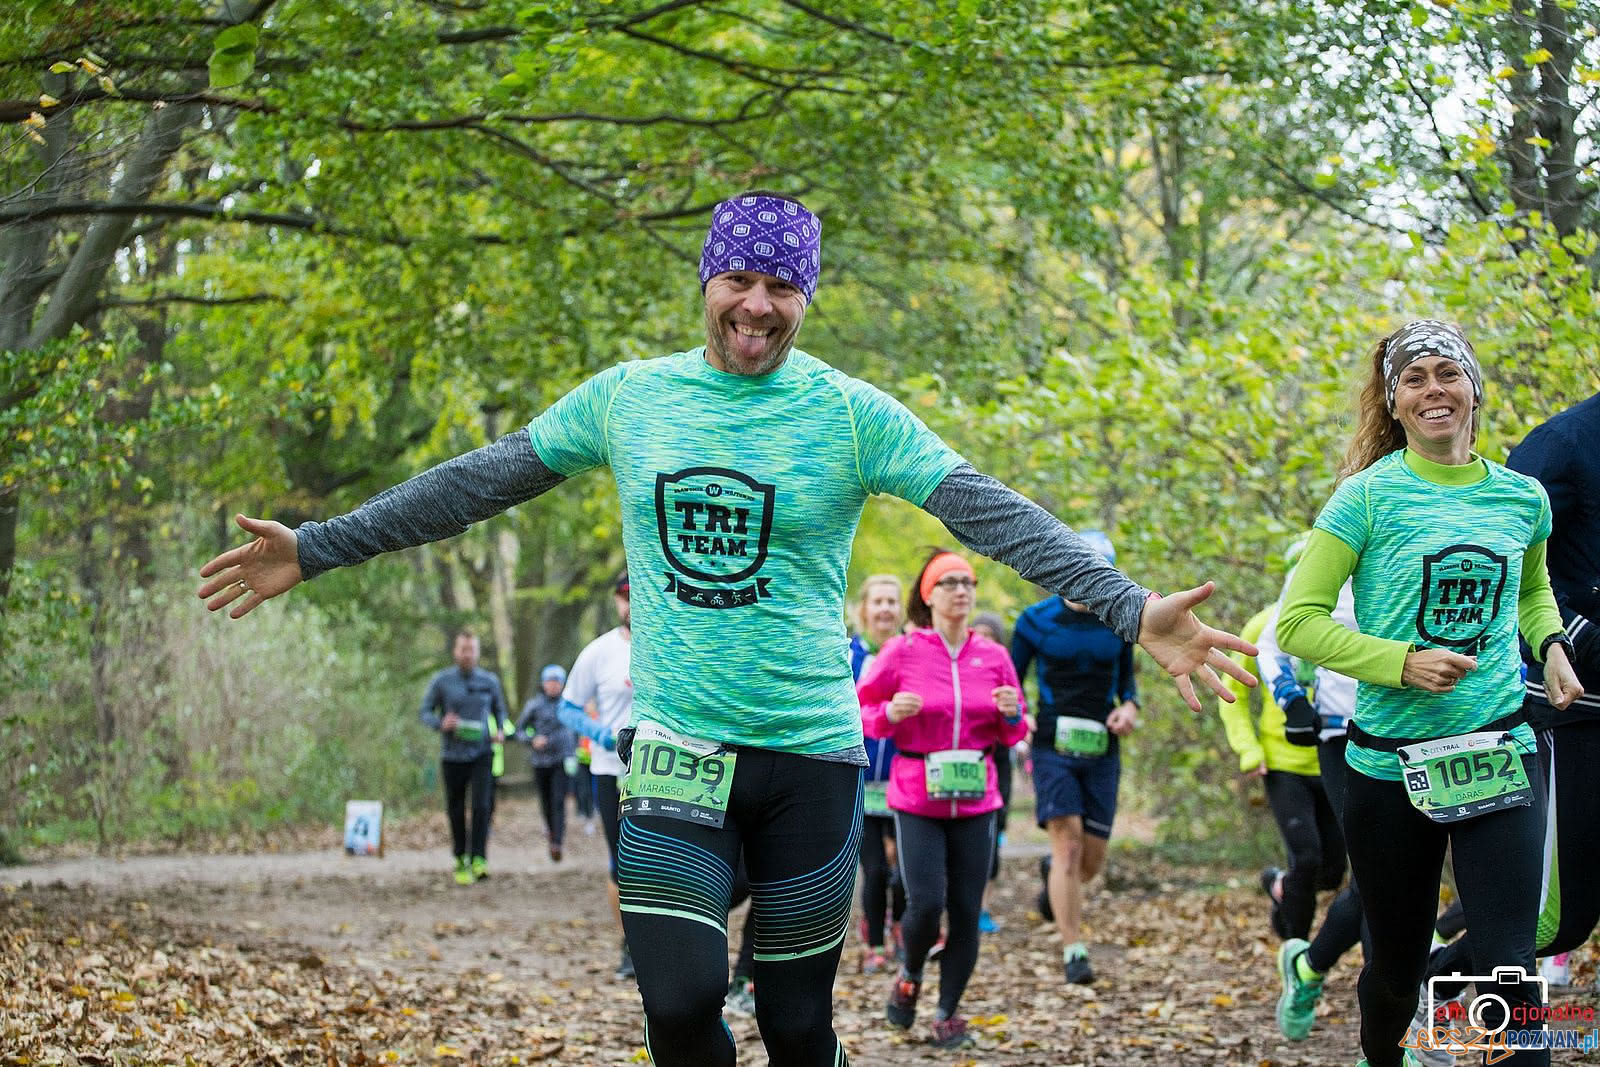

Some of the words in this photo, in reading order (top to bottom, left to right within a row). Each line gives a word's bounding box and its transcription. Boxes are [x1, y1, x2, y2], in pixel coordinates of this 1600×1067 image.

[707, 486, 720, 494] W
[675, 501, 750, 535] TRI
[677, 534, 747, 556] TEAM
[1438, 578, 1491, 604] TRI
[1432, 608, 1484, 625] TEAM
[639, 743, 725, 787] 1039
[1434, 748, 1517, 789] 1052
[639, 783, 684, 797] MARASSO
[1455, 789, 1485, 802] DARAS
